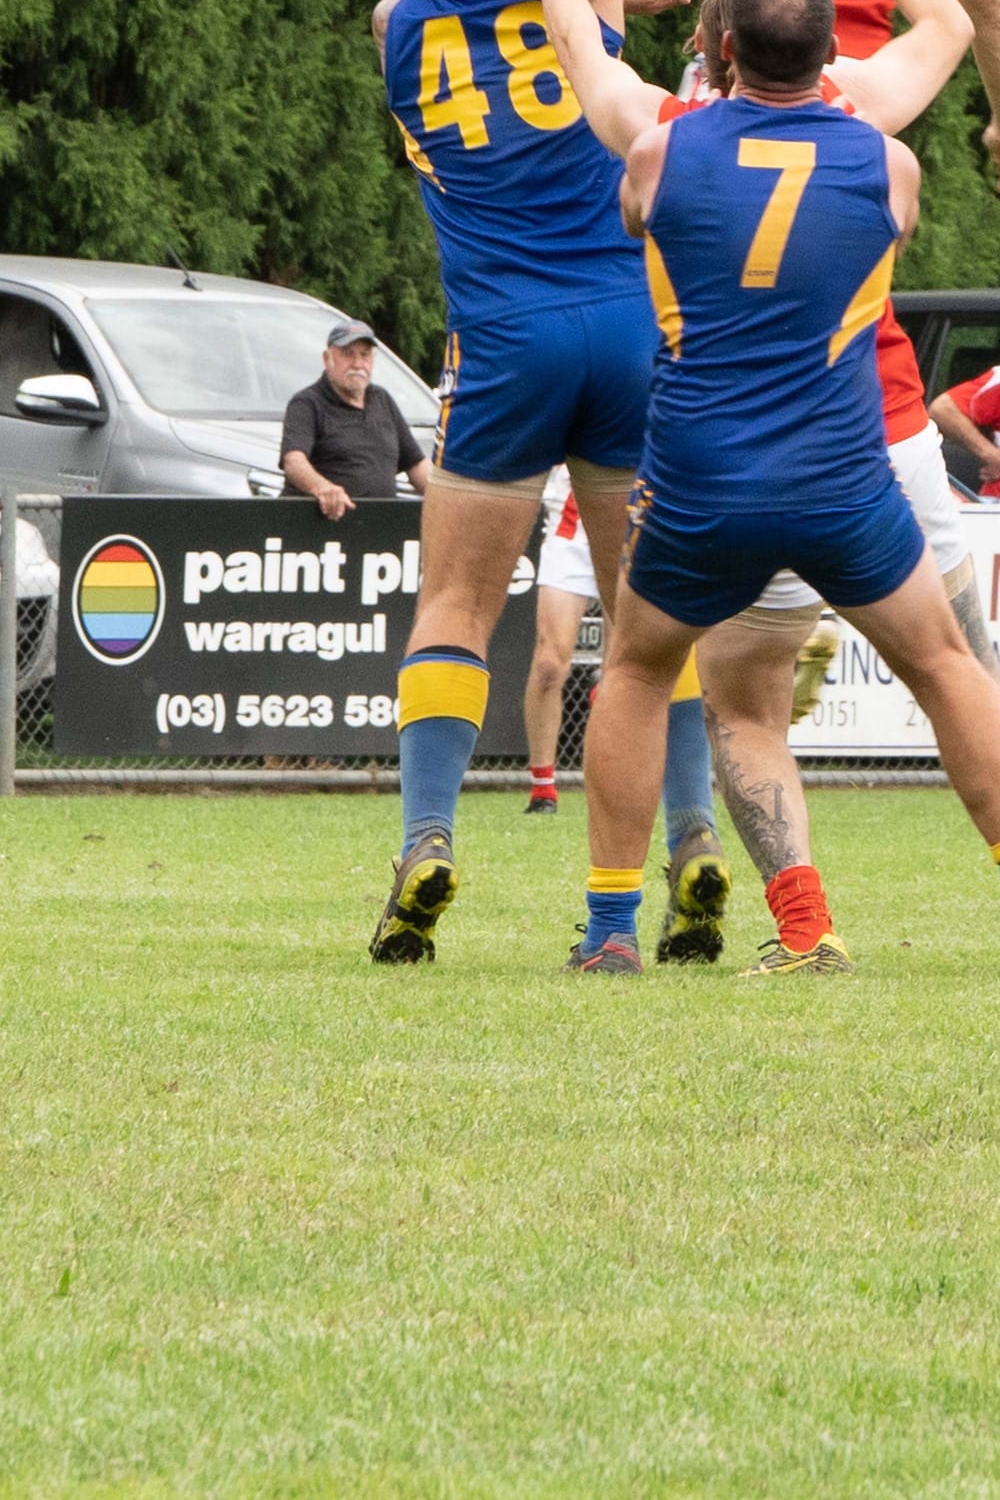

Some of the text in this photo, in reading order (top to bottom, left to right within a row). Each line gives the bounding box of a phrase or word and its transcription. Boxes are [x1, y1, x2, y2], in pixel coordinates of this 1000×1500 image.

[417, 1, 583, 149] 48
[737, 138, 816, 288] 7
[184, 537, 535, 605] paint ple
[184, 613, 386, 660] warragul
[156, 693, 400, 733] (03) 5623 58
